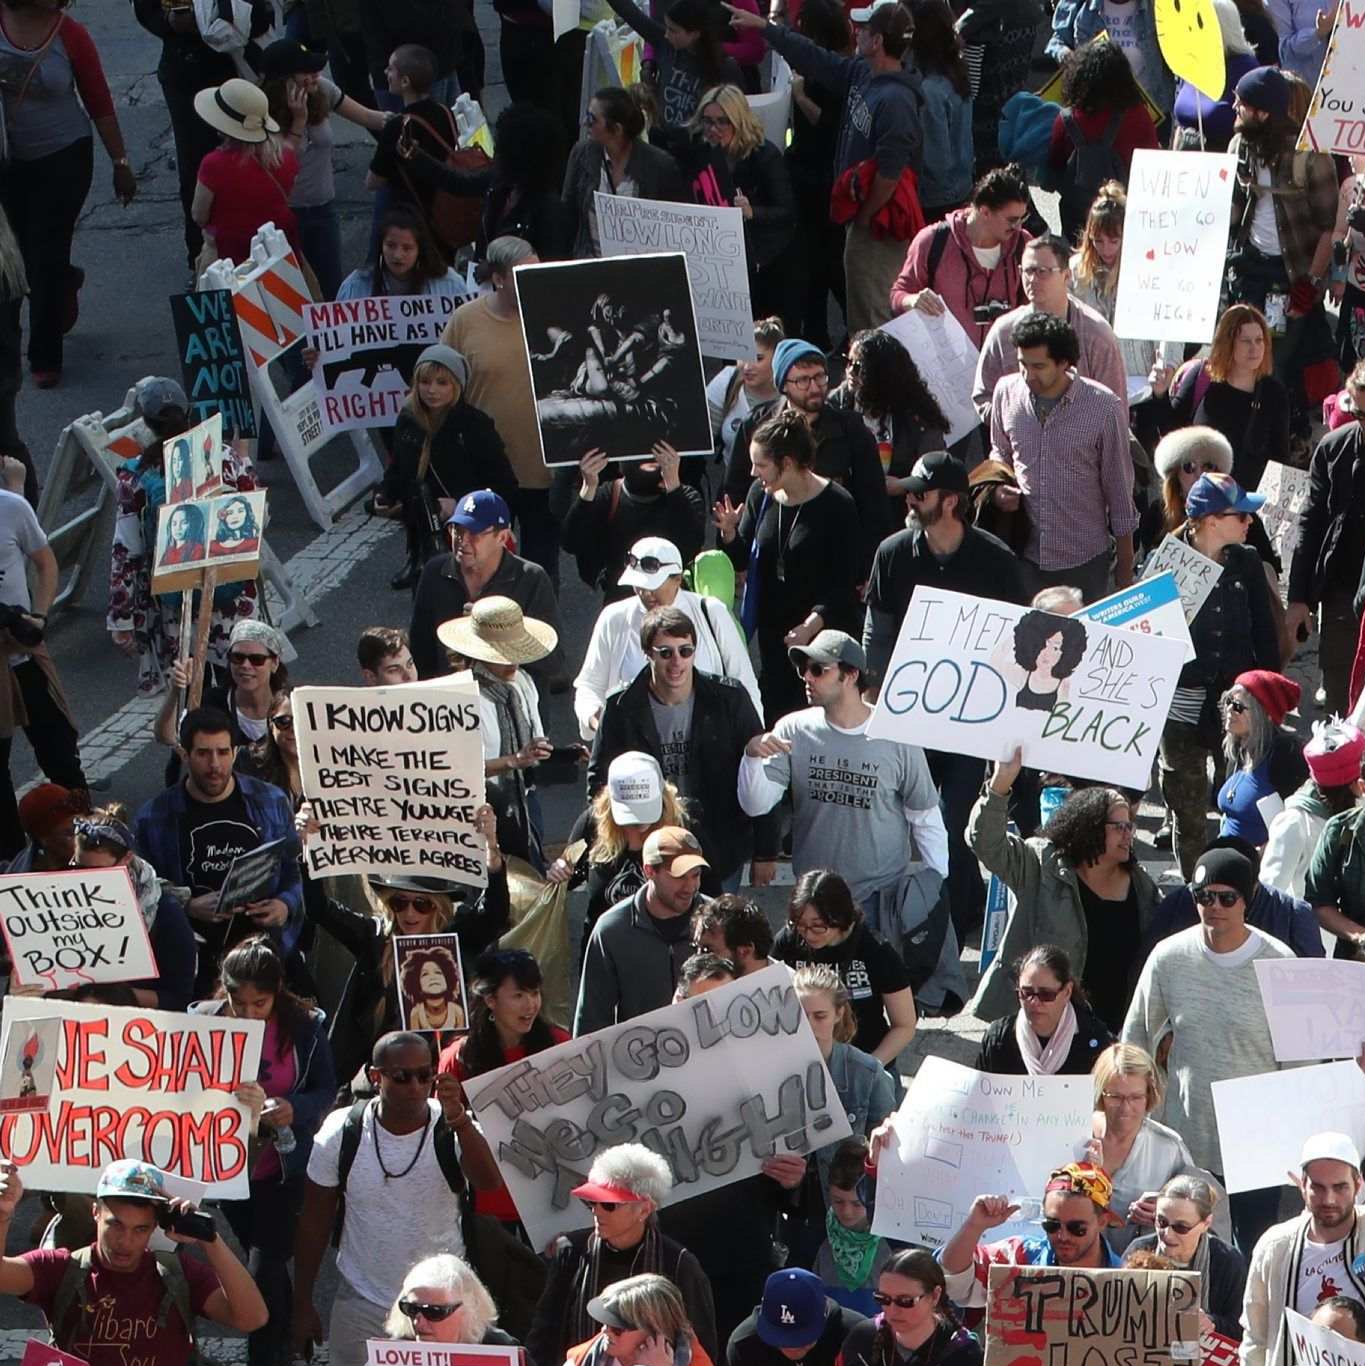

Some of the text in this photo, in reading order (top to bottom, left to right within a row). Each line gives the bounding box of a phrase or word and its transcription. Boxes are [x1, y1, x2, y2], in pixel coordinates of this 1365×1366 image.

[1320, 88, 1352, 114] You
[185, 291, 230, 324] WE
[310, 297, 434, 330] MAYBE ONE
[186, 323, 238, 364] ARE
[192, 361, 242, 398] NOT
[910, 600, 1014, 651] I MET
[884, 658, 1007, 723] GOD
[306, 702, 317, 730] I
[326, 703, 405, 733] KNOW
[1041, 701, 1151, 757] BLACK
[319, 769, 374, 789] BEST
[807, 767, 878, 788] PRESIDENT
[809, 790, 873, 809] PROBLEM
[0, 882, 116, 911] Think
[114, 1018, 249, 1094] SHALL
[473, 985, 801, 1121] THEY GO LOW
[1015, 1271, 1197, 1349] TRUMP
